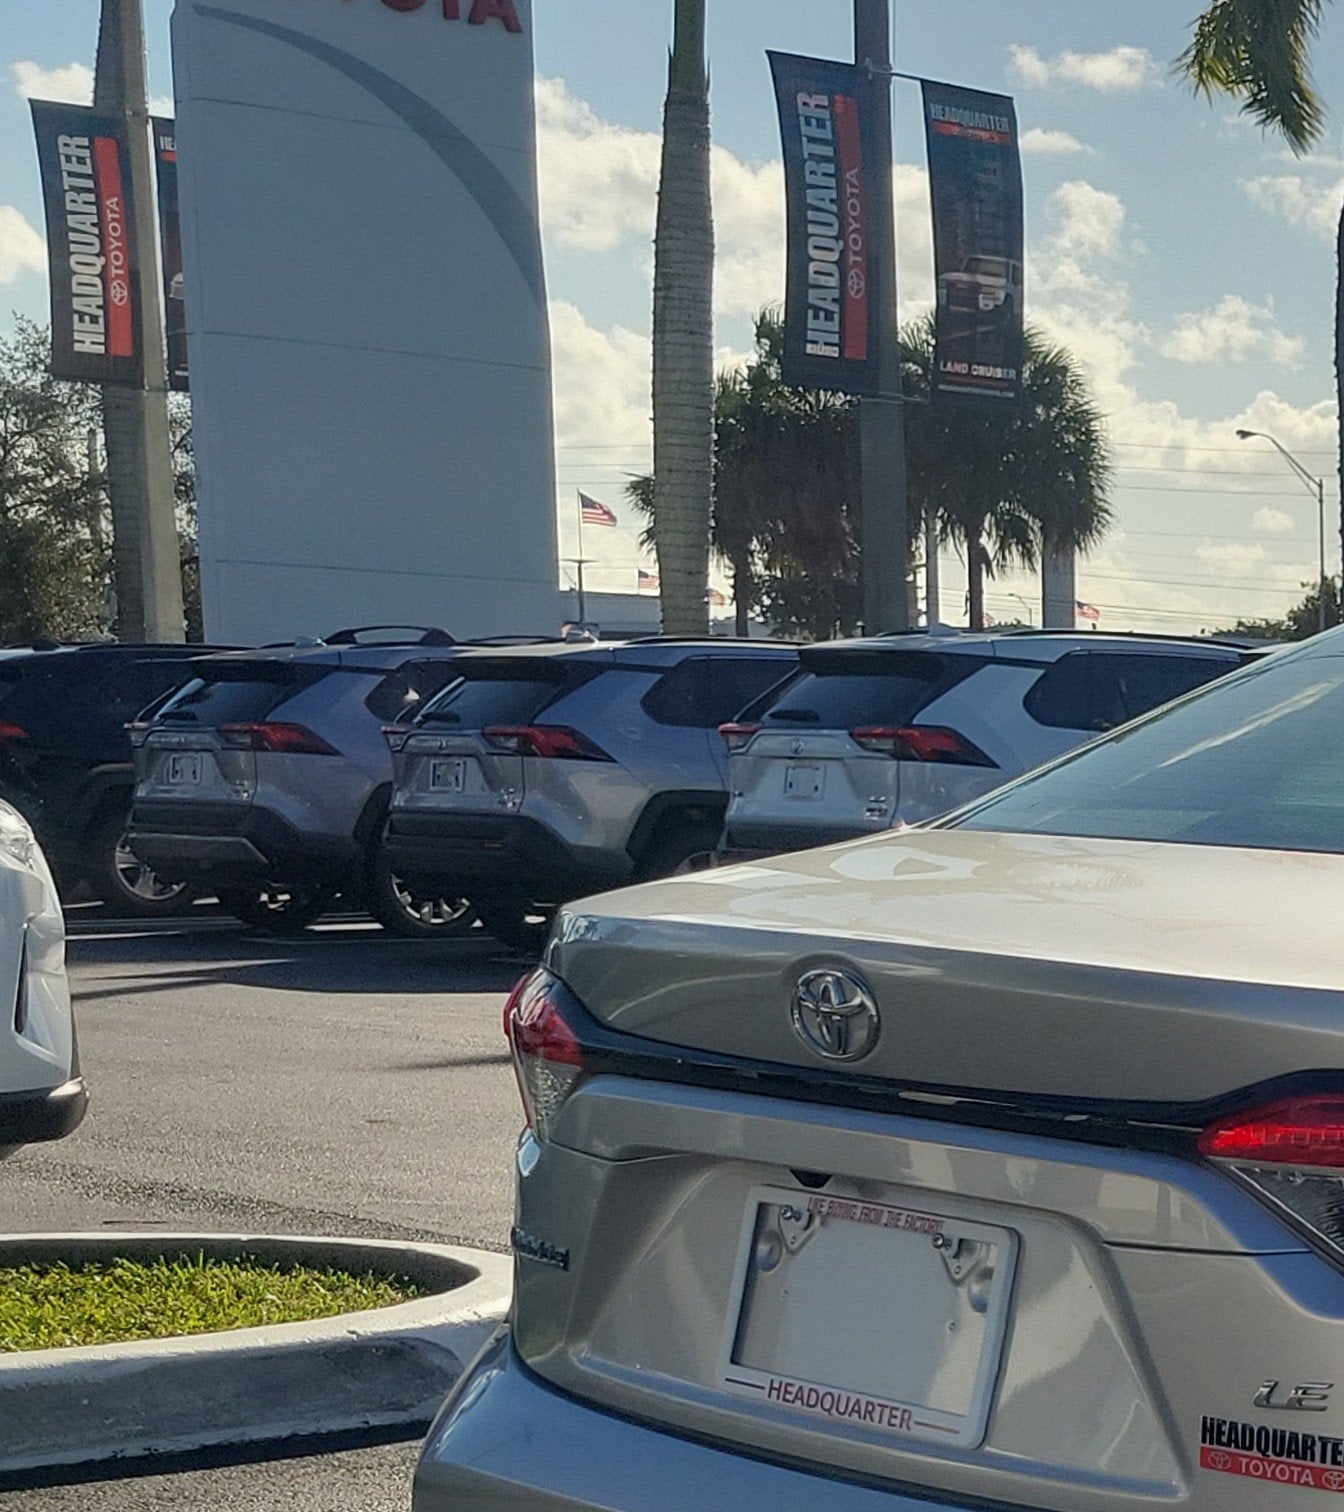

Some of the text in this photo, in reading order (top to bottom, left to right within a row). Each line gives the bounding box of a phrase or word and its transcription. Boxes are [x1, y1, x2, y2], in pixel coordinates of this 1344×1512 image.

[930, 103, 1009, 132] HEADQUARTER
[106, 197, 125, 278] TOYOTA
[797, 92, 844, 358] HEADQUARTER
[846, 166, 863, 263] TOYOTA
[57, 134, 106, 354] HEADQUARTER
[940, 361, 1017, 380] LAND CRUISER
[767, 1379, 913, 1431] HEADQUARTER
[1253, 1379, 1334, 1411] LE
[1239, 1456, 1315, 1487] TOYOTA
